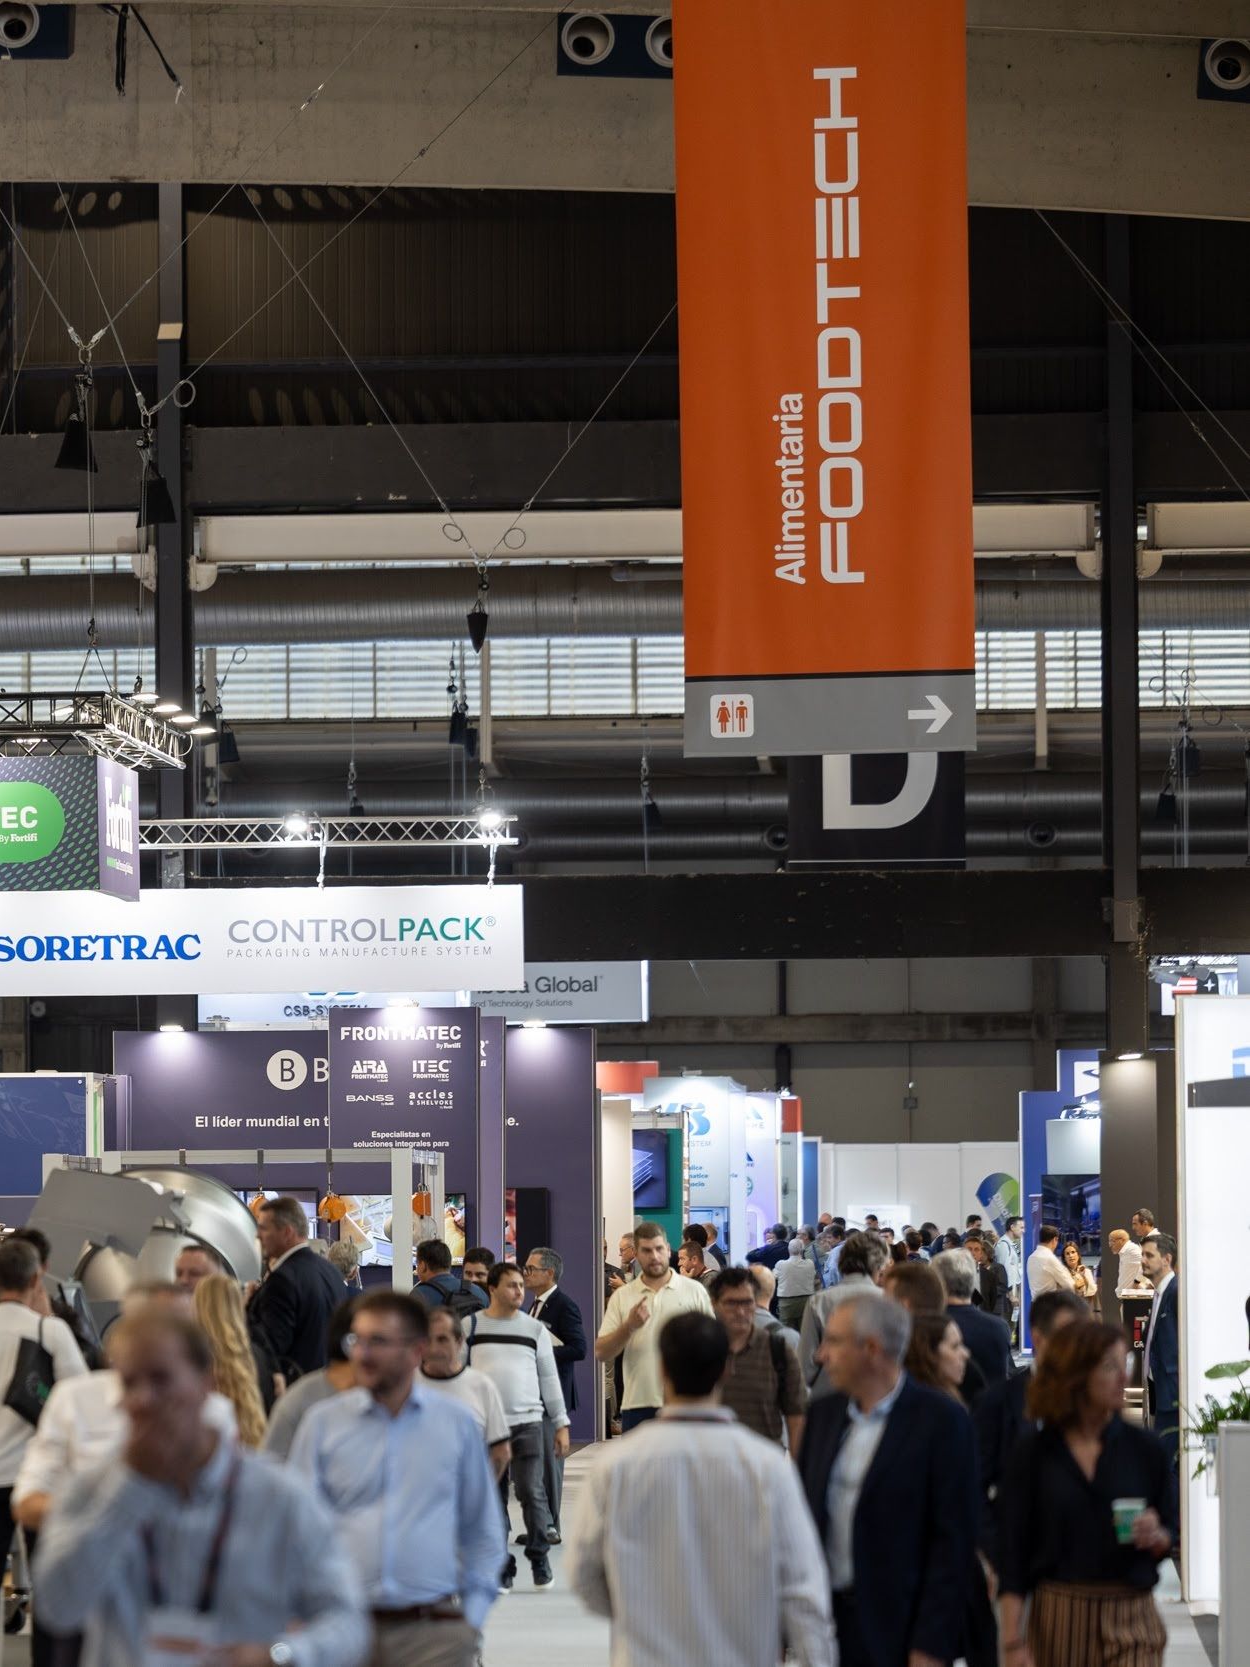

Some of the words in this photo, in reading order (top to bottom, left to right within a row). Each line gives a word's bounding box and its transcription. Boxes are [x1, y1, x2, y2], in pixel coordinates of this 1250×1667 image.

[813, 67, 865, 583] FOODTECH
[772, 393, 806, 585] Alimentaria
[10, 833, 38, 842] Fortifi
[226, 947, 311, 958] PACKAGING
[319, 946, 428, 957] MANUFACTURE
[436, 946, 492, 956] SYSTEM
[535, 975, 598, 993] Global
[488, 1000, 534, 1009] Technology
[535, 999, 574, 1008] Solutions
[340, 1026, 462, 1041] FRONTMATEC
[412, 1060, 449, 1072] ITEC
[409, 1090, 453, 1099] accles
[195, 1116, 208, 1128] El
[212, 1115, 242, 1128] líder
[246, 1115, 299, 1127] mundial
[303, 1117, 320, 1127] en
[371, 1131, 420, 1139] Especialistas
[395, 1141, 431, 1149] integrales
